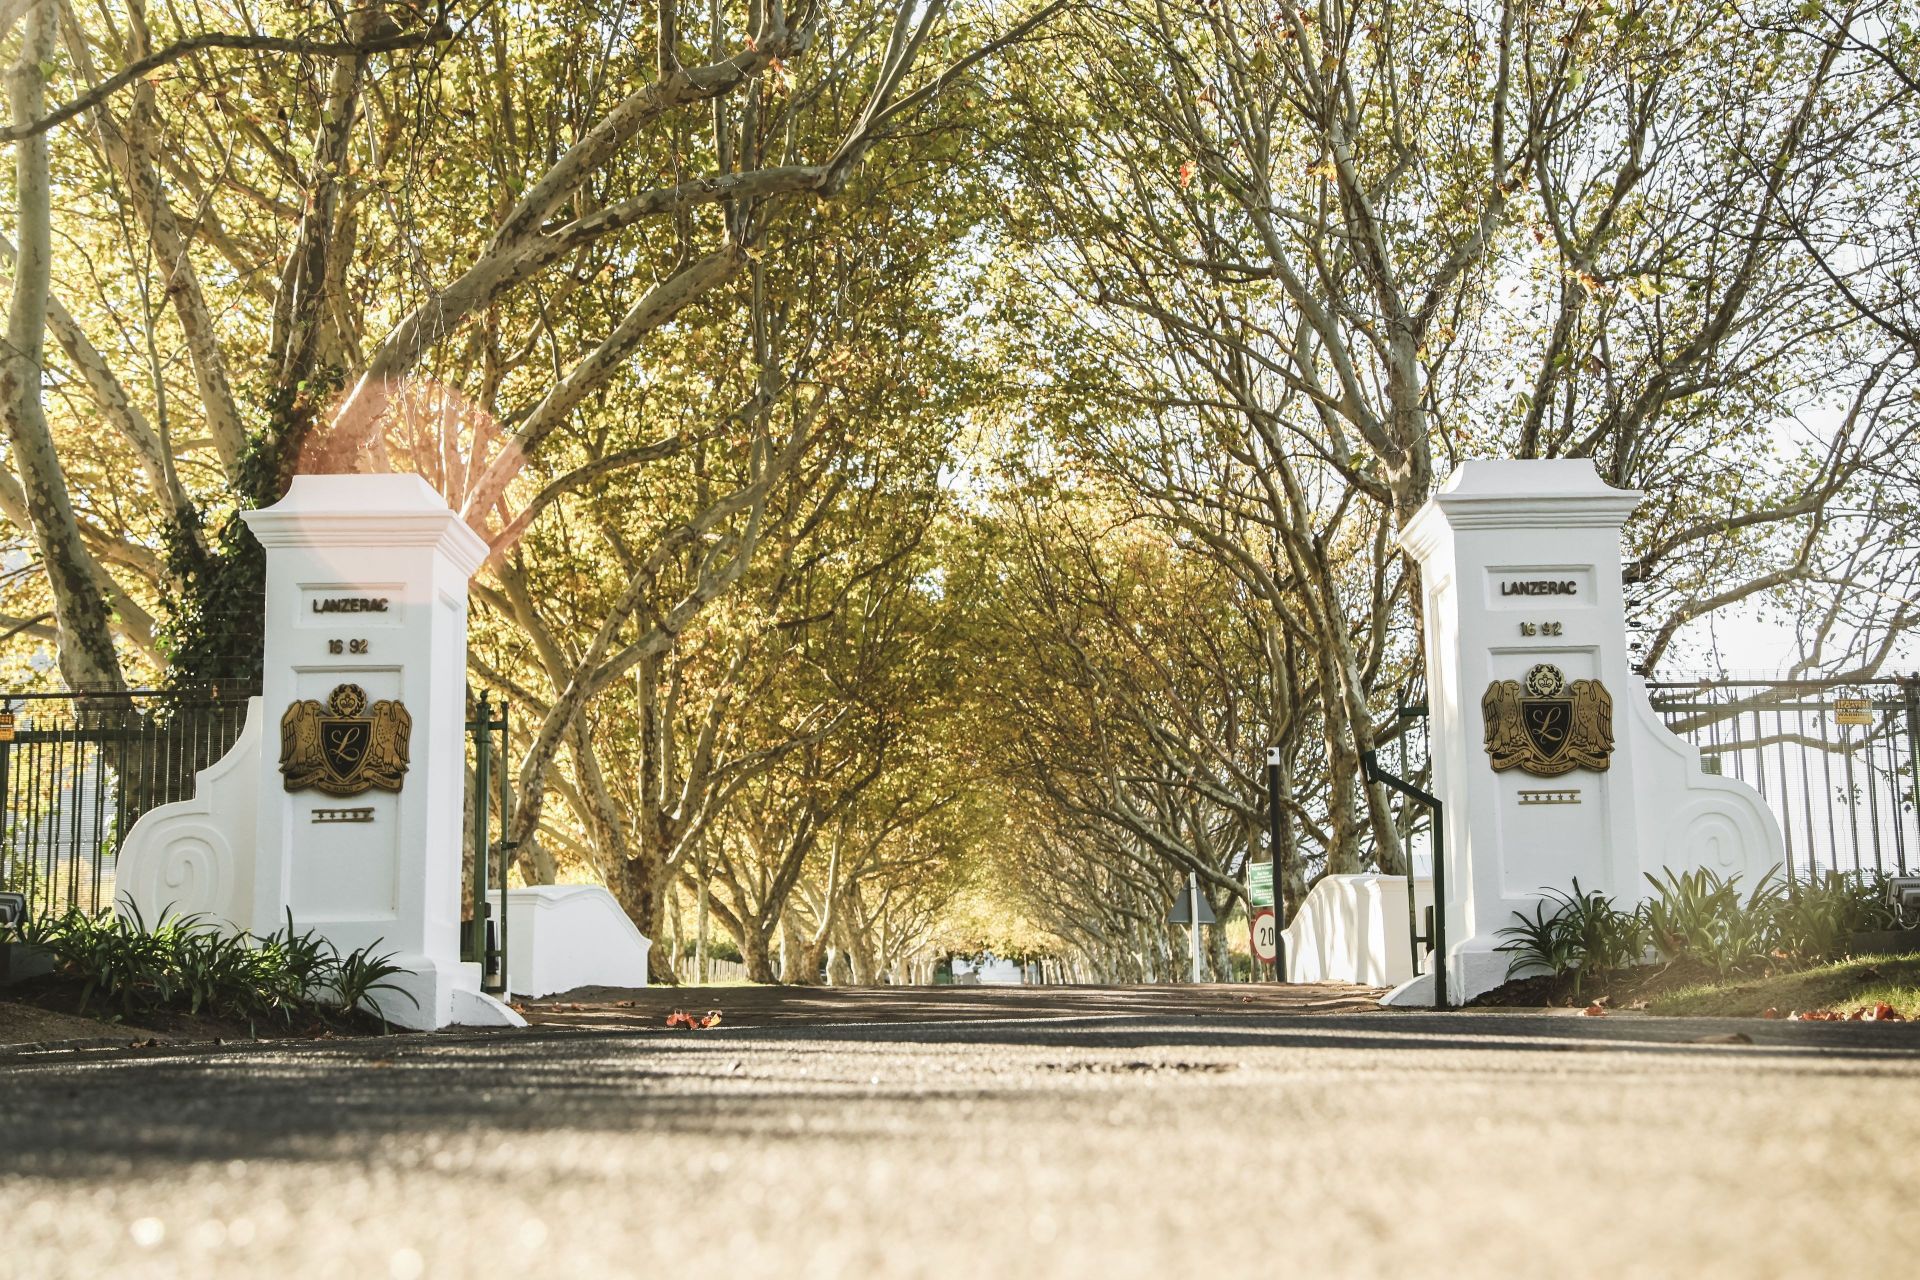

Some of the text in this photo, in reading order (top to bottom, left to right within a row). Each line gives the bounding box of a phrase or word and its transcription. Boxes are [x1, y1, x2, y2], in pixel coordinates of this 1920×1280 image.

[1502, 581, 1577, 595] LANZERAC
[313, 598, 388, 613] LANZERAC
[328, 638, 369, 654] 16 92
[1532, 706, 1563, 745] L
[330, 727, 360, 763] L
[1540, 765, 1560, 773] HINC
[1260, 926, 1275, 947] 20
